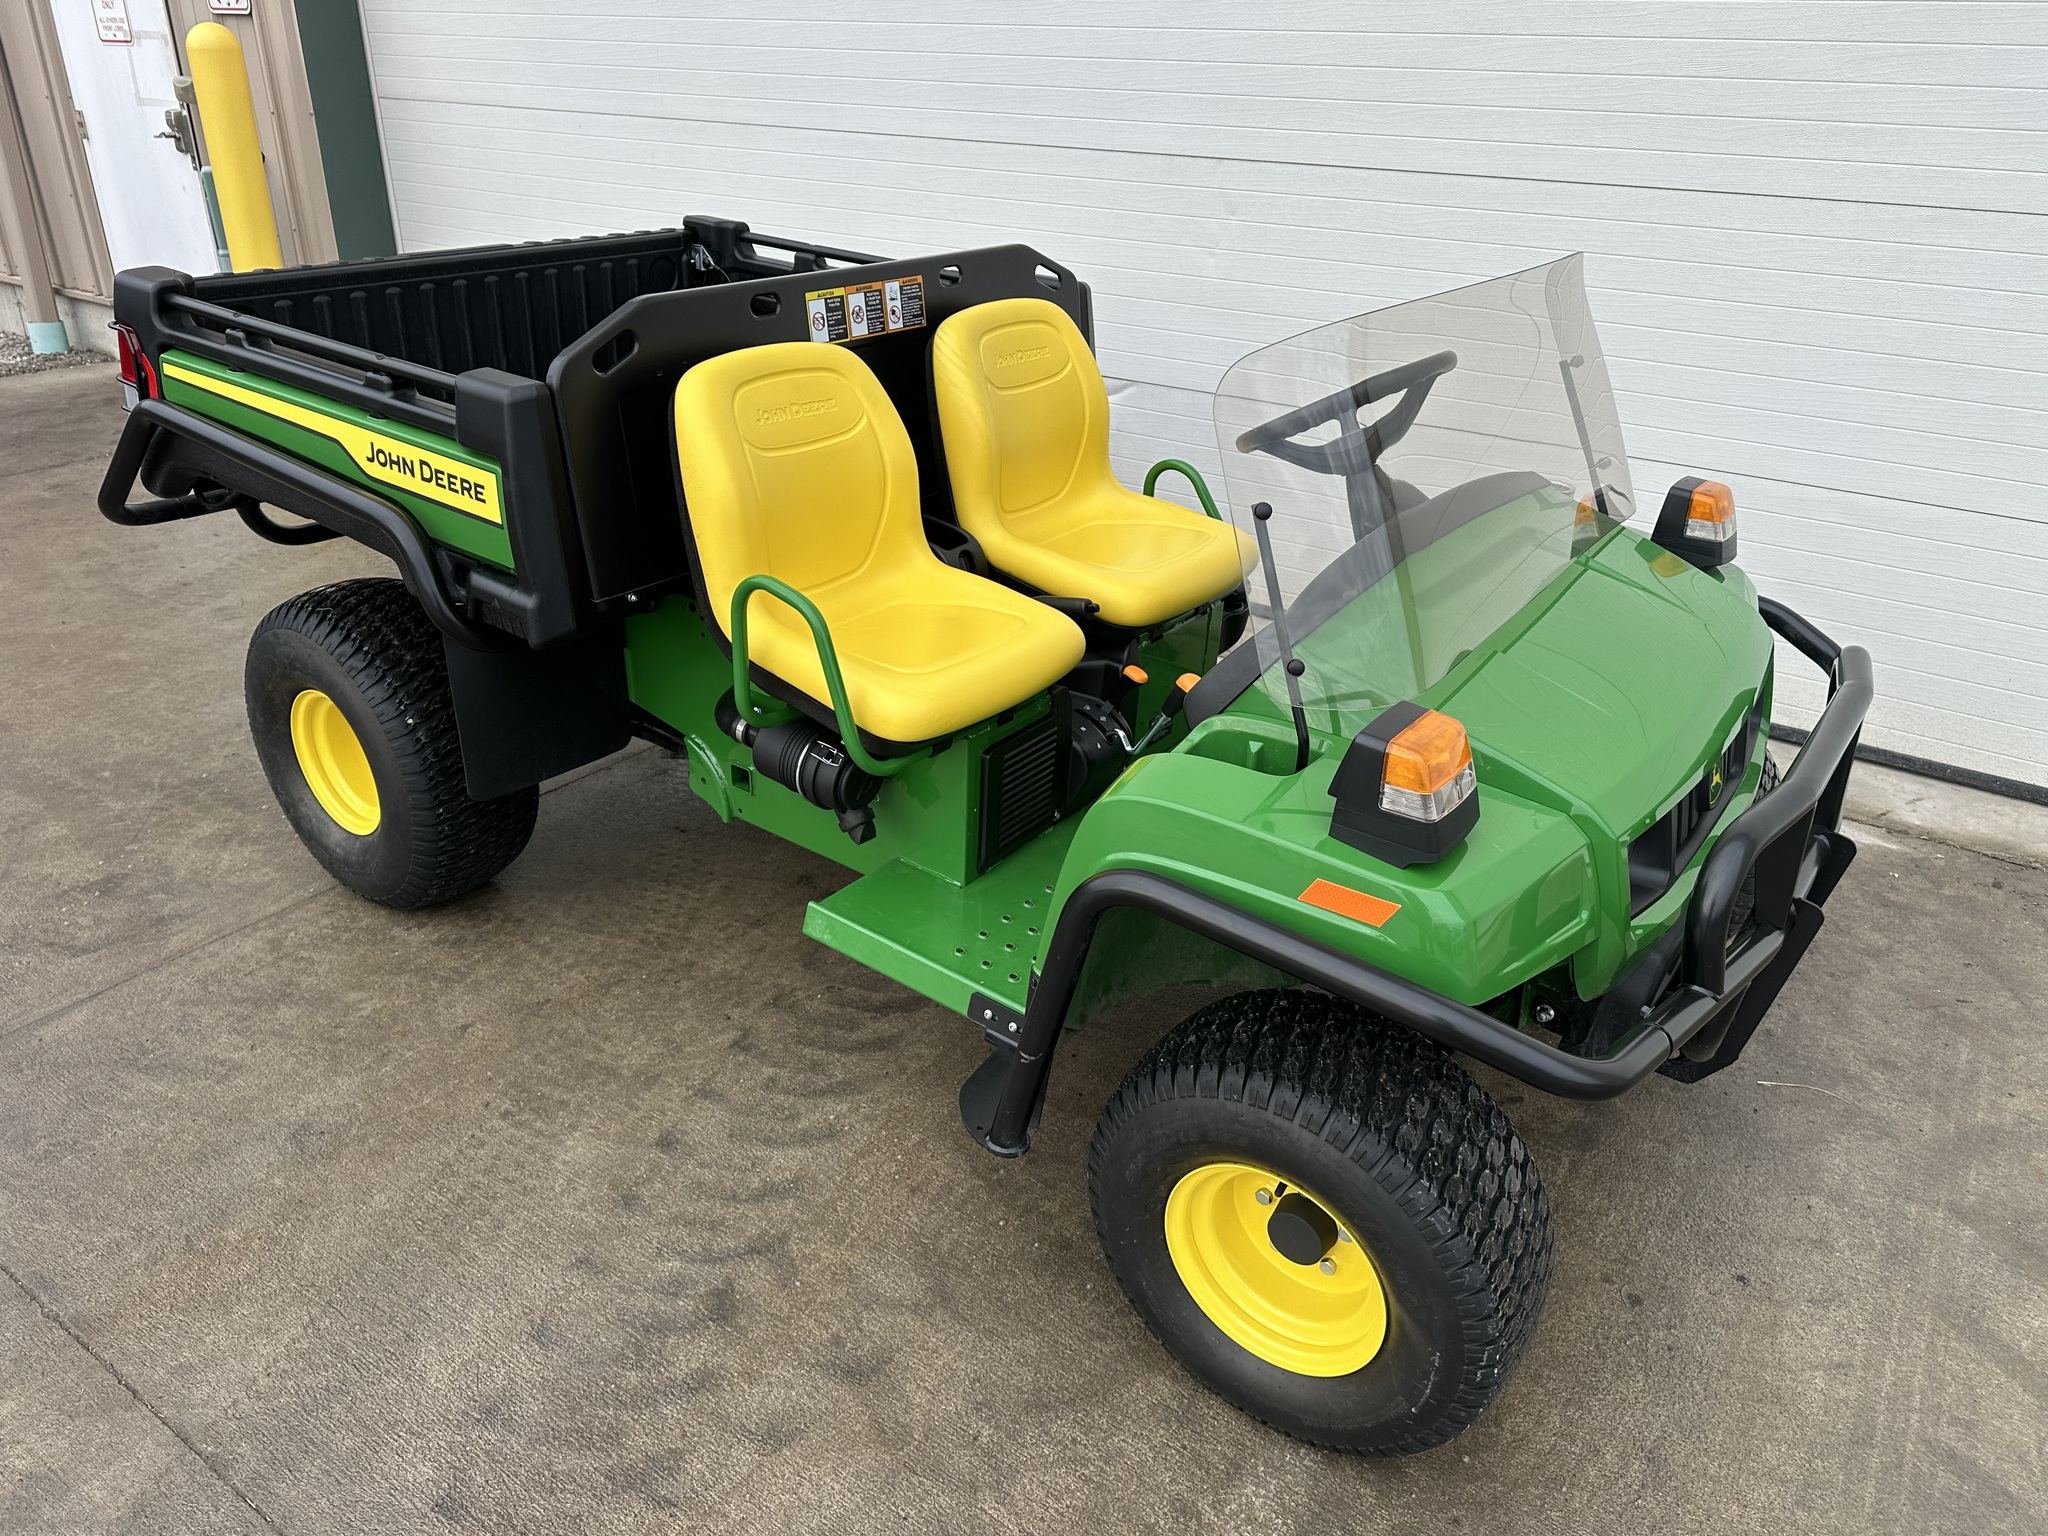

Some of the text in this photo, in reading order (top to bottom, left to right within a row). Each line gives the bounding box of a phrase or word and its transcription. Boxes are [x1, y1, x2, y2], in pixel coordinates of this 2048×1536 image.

[994, 345, 1051, 368] JOHN DEERE
[757, 398, 838, 425] JOHN DEERE
[366, 441, 487, 504] JOHN DEERE
